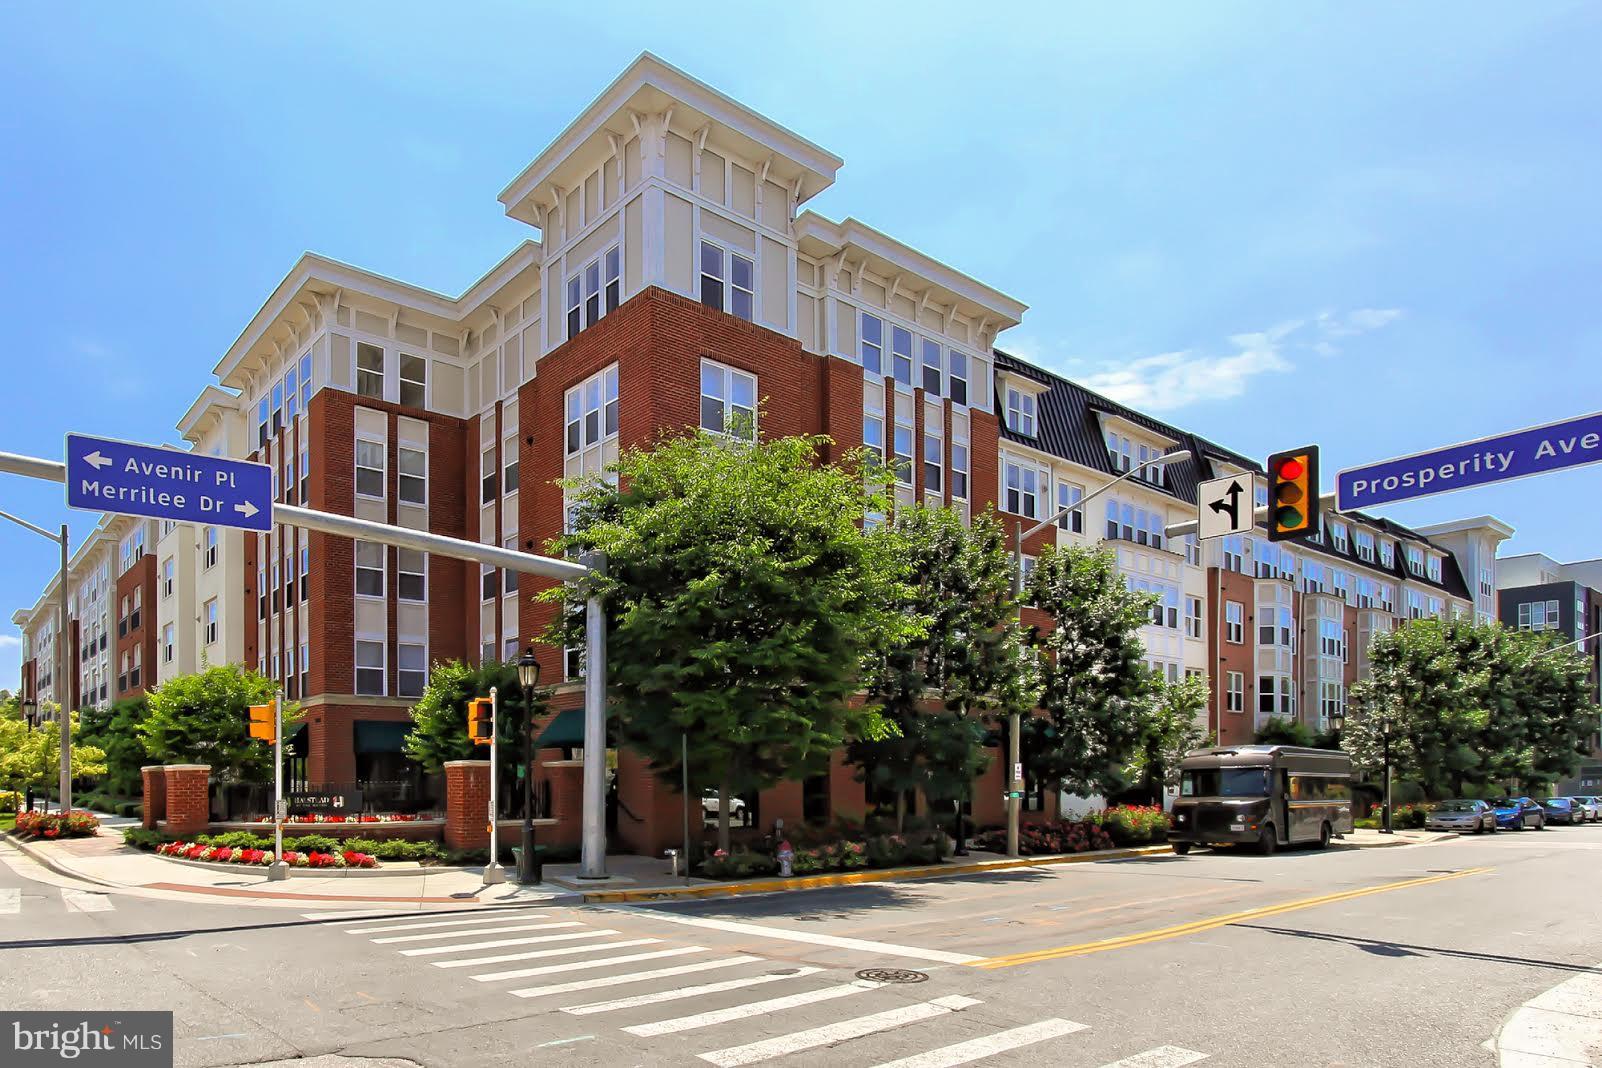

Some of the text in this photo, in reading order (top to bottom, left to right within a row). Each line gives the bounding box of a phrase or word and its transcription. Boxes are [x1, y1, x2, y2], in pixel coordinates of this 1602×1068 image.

[124, 456, 236, 489] Avenir Pl
[1352, 432, 1601, 497] Prosperity Ave
[81, 479, 224, 513] Merrilee Dr
